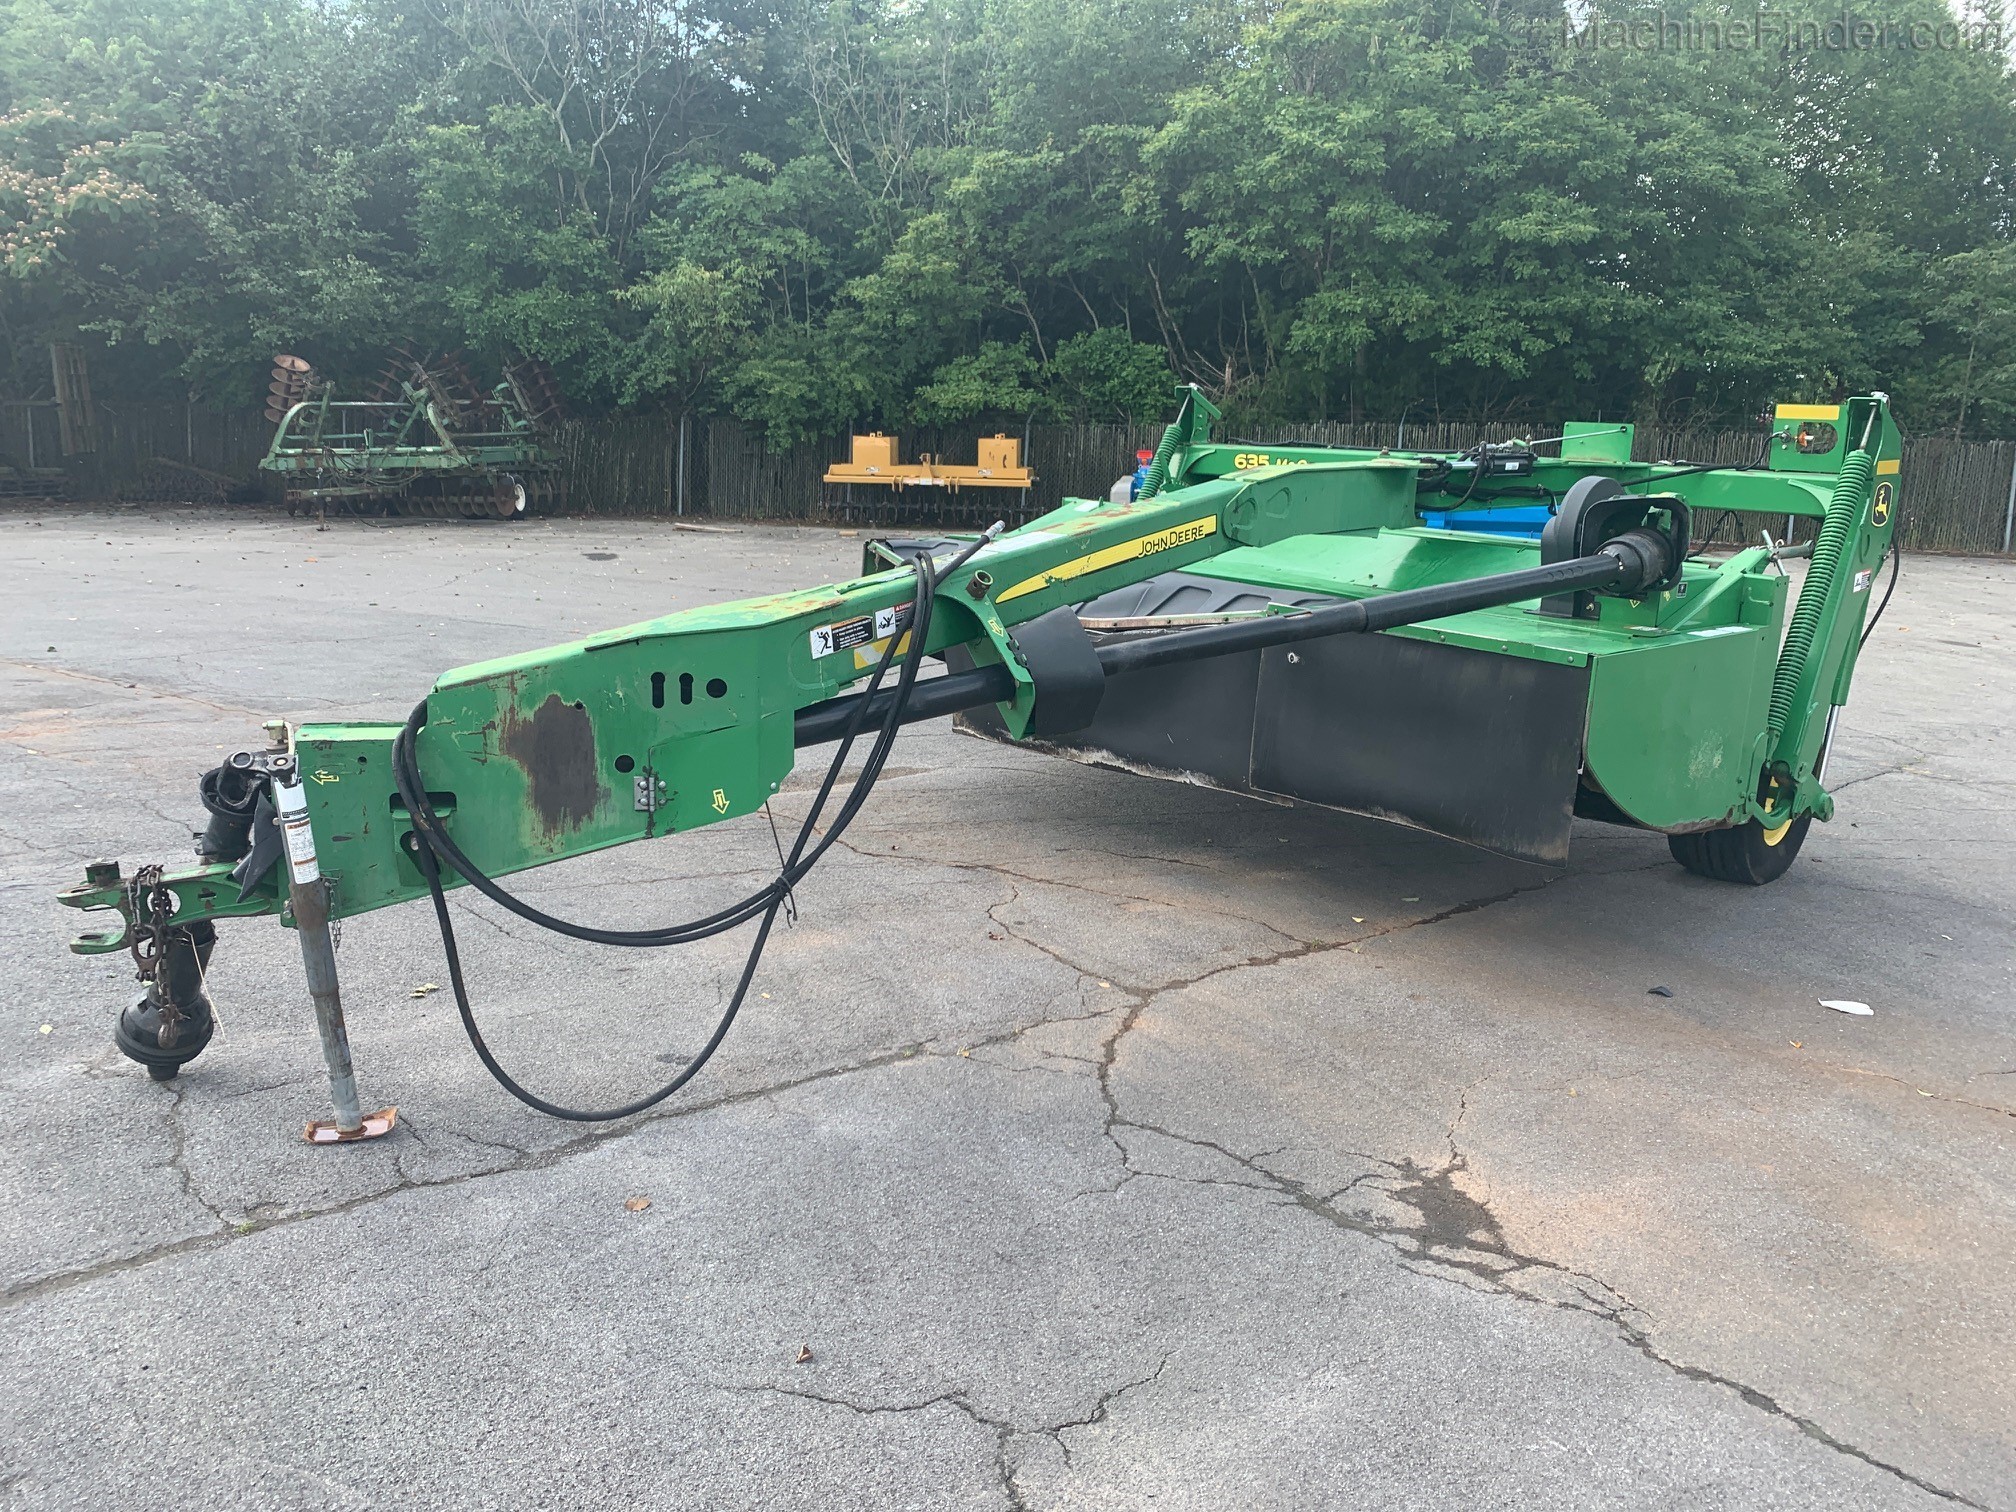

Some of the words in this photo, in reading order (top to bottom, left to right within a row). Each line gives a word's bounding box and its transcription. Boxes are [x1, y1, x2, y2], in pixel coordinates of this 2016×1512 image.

[1234, 453, 1270, 469] 635
[1138, 536, 1168, 556] JOHN
[1169, 525, 1204, 546] DEERE
